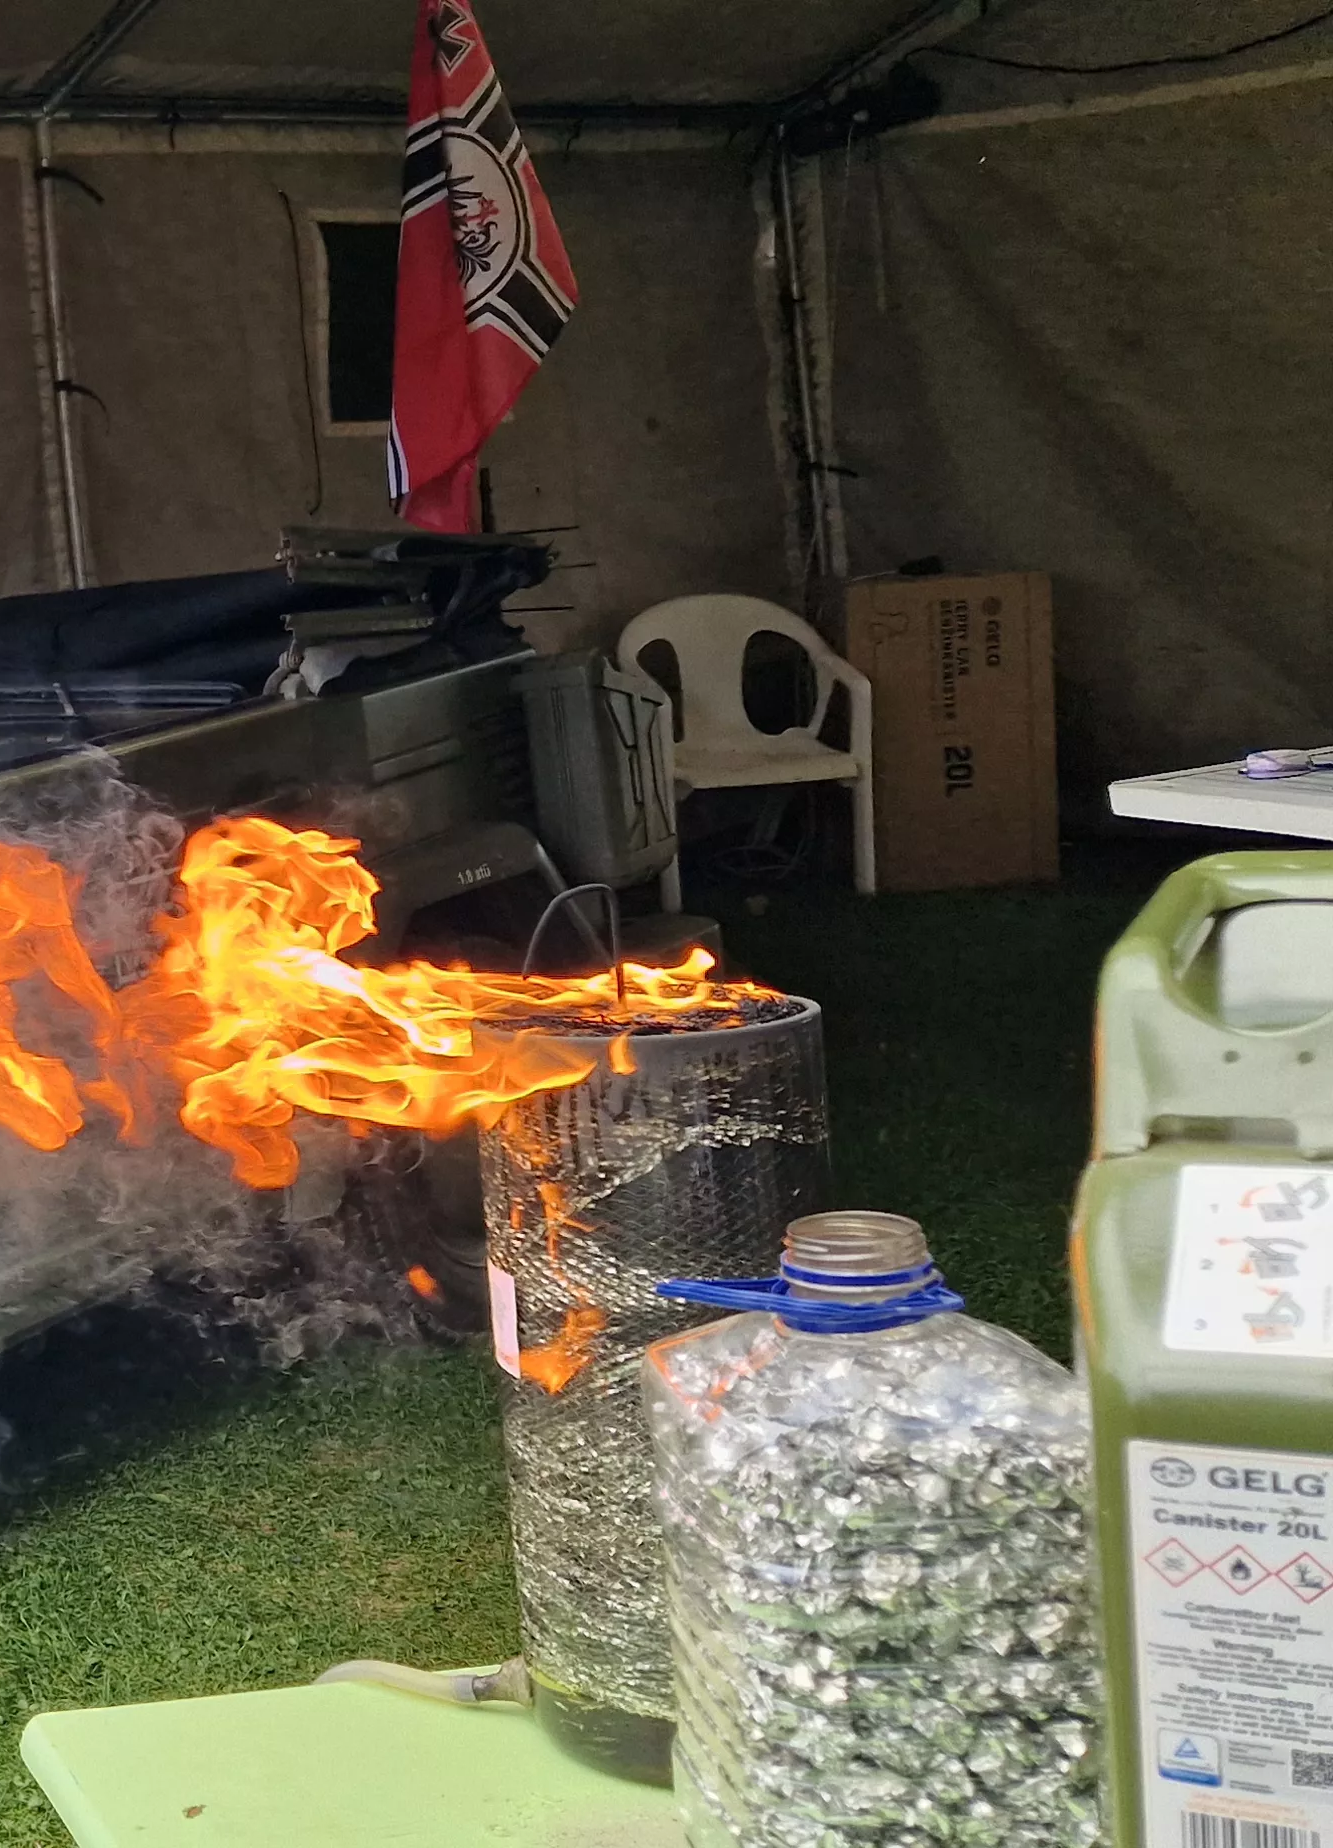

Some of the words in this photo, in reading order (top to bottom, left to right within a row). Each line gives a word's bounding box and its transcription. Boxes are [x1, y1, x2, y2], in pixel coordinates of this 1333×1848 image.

[944, 747, 973, 798] 20L
[1200, 1258, 1214, 1270] 2
[1208, 1466, 1326, 1497] GELG
[1153, 1508, 1269, 1535] Canister
[1277, 1520, 1329, 1541] 20L
[1213, 1638, 1274, 1659] Warning
